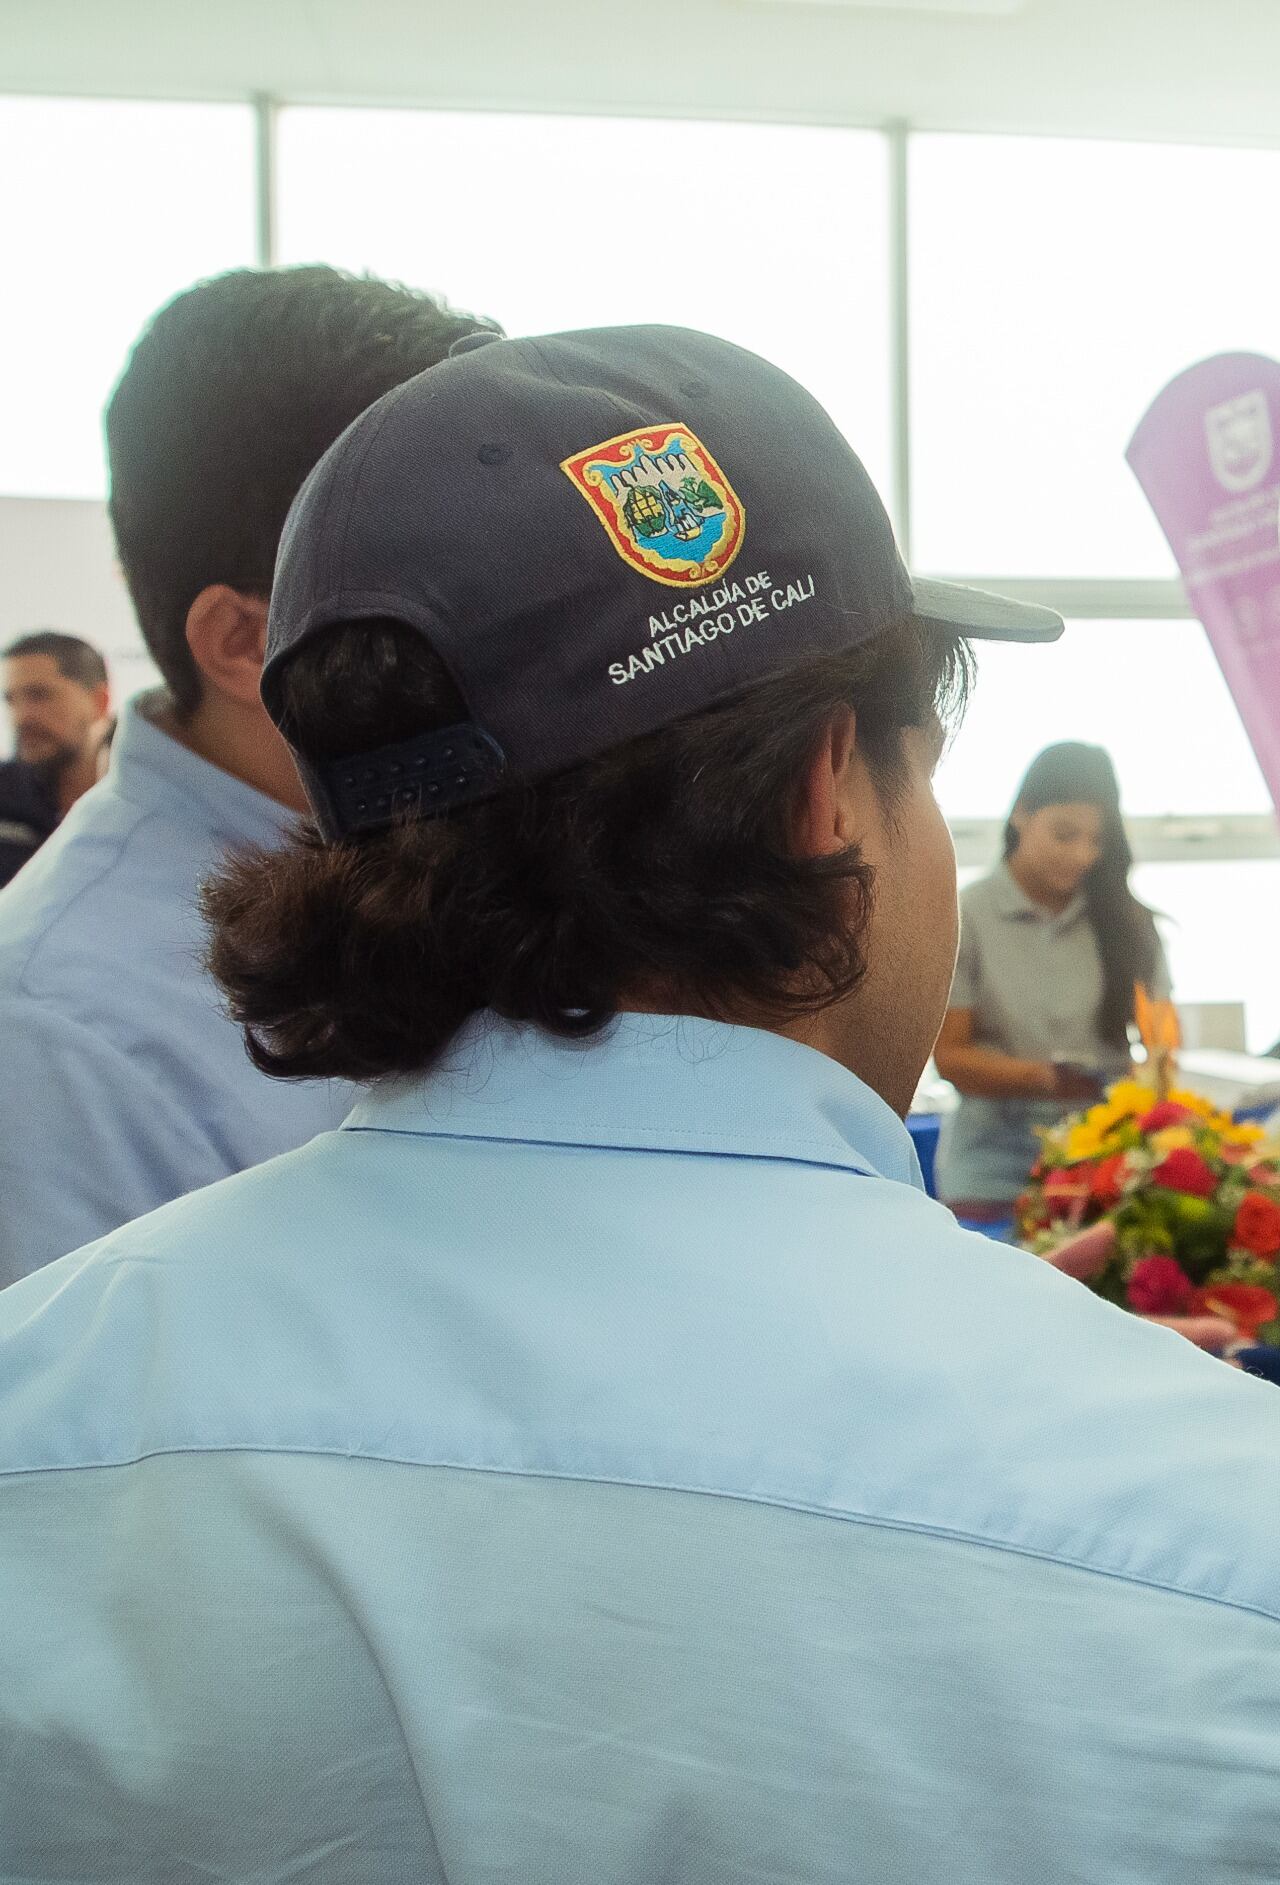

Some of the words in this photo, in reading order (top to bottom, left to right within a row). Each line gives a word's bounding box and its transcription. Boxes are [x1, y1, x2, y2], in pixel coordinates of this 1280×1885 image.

[608, 612, 735, 685] SANTIAGO
[736, 597, 770, 627] DE
[771, 575, 816, 611] CALI
[648, 578, 745, 637] ALCALDÍA
[746, 571, 773, 595] DE
